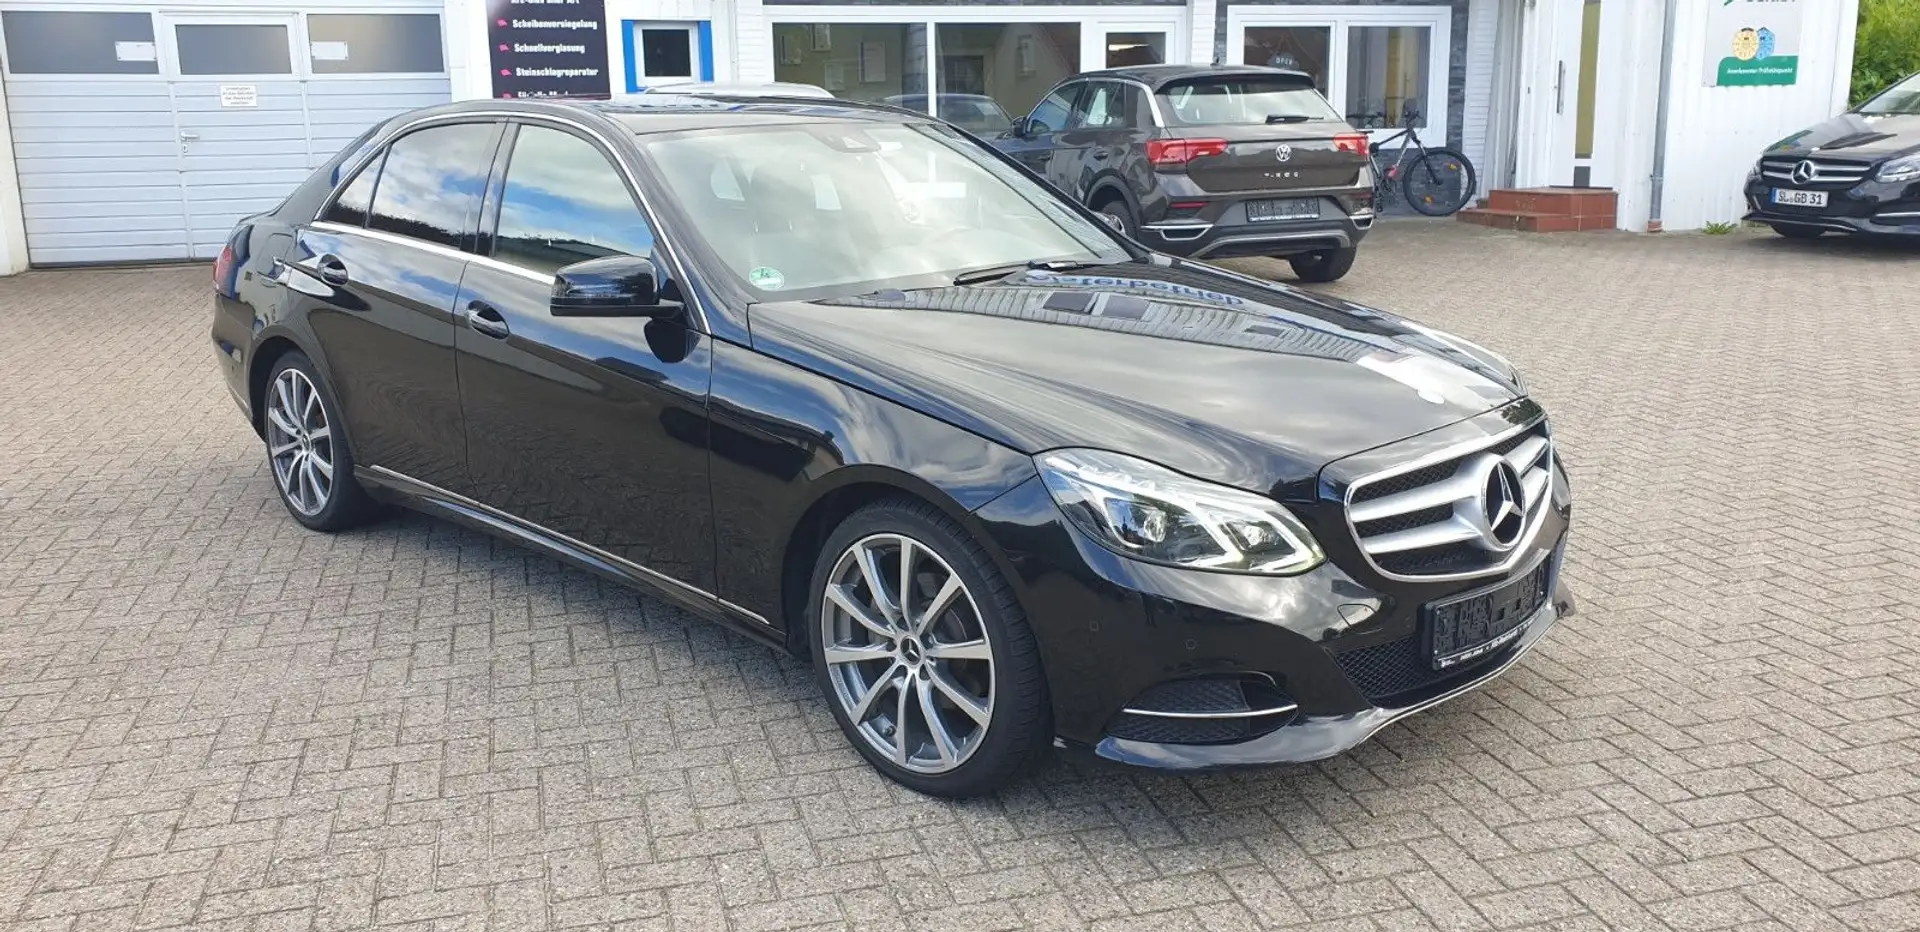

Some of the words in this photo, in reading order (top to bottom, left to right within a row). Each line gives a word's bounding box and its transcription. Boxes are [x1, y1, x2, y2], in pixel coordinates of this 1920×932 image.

[512, 19, 597, 29] Scheibenversiegelung
[514, 43, 585, 54] Schnellverglasung
[1809, 193, 1822, 205] 31
